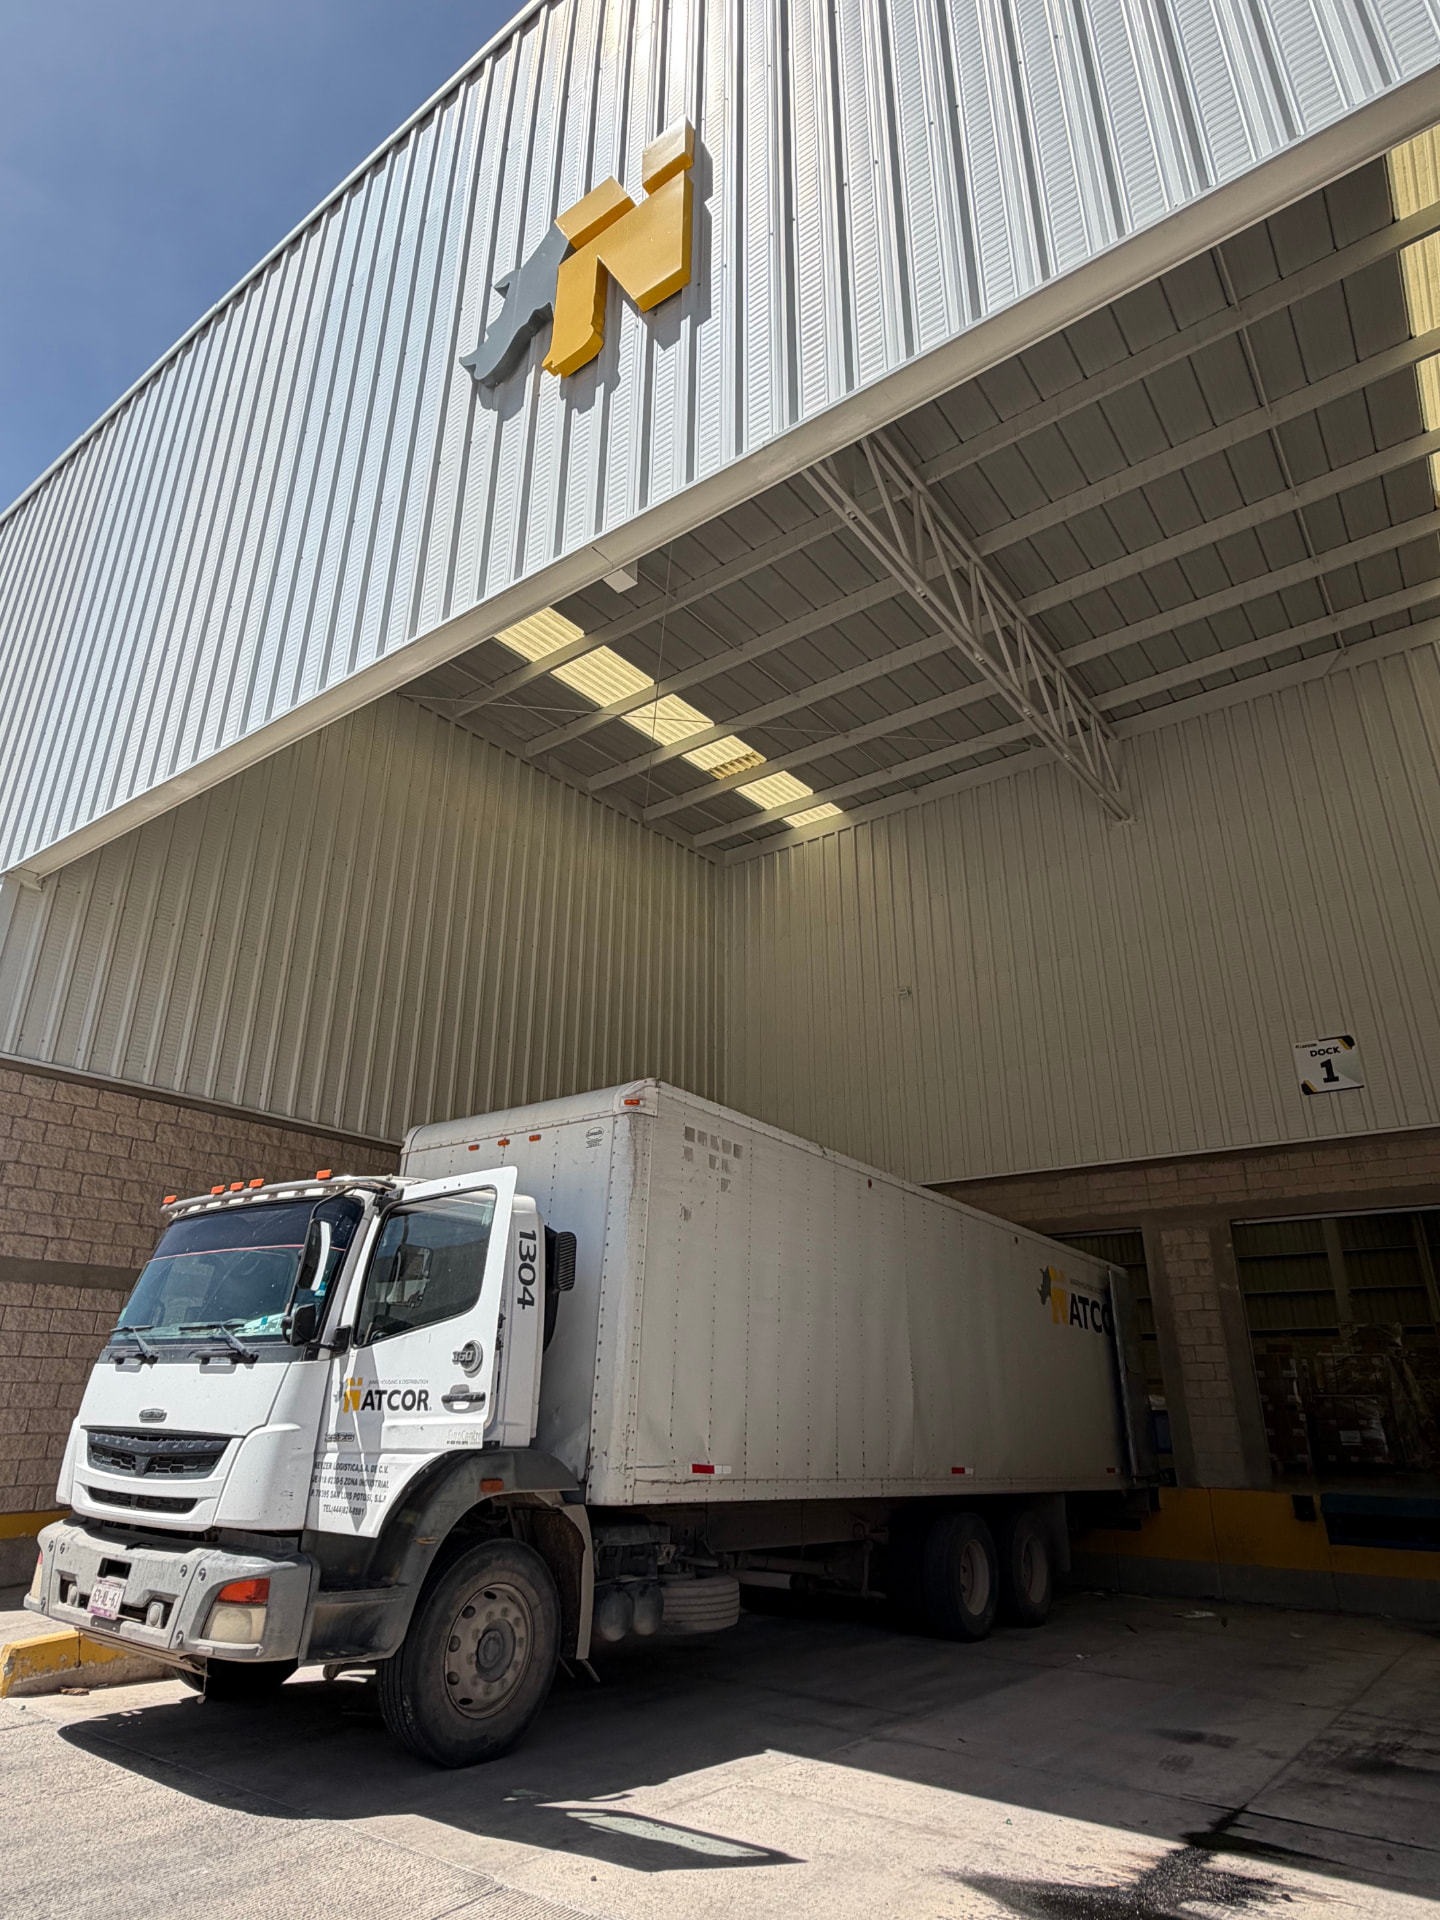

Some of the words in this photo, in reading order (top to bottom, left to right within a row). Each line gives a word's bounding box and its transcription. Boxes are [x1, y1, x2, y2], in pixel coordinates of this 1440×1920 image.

[1310, 1047, 1341, 1057] DOCK
[1320, 1059, 1339, 1083] 1
[517, 1230, 537, 1310] 1304
